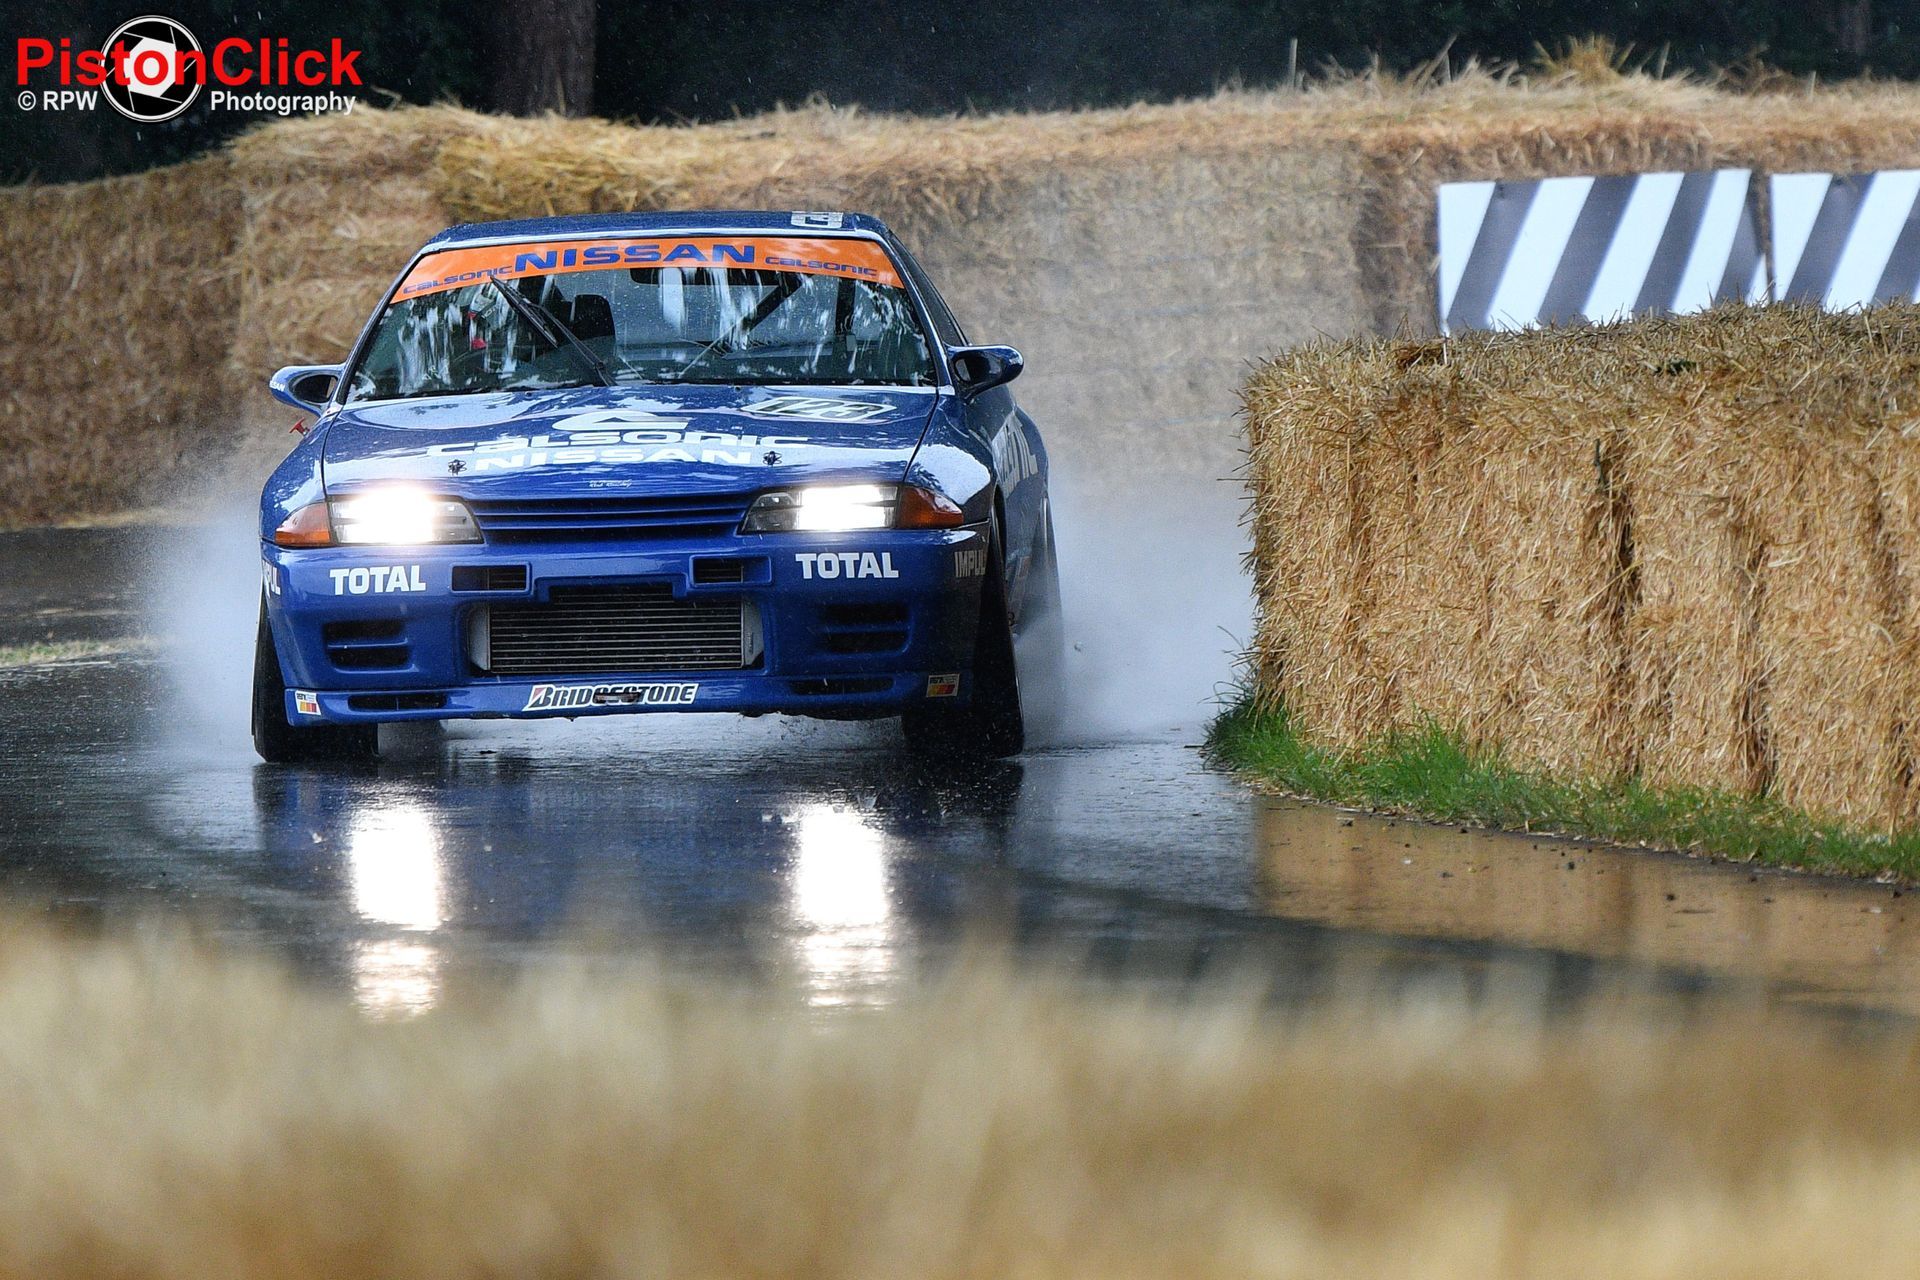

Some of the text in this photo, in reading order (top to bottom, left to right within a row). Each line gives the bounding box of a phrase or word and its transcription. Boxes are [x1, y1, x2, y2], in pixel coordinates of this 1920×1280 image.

[515, 244, 755, 273] NISSAN
[756, 399, 884, 419] 123
[475, 448, 751, 470] NISSAN
[795, 552, 899, 579] TOTAL
[329, 565, 427, 595] TOTAL
